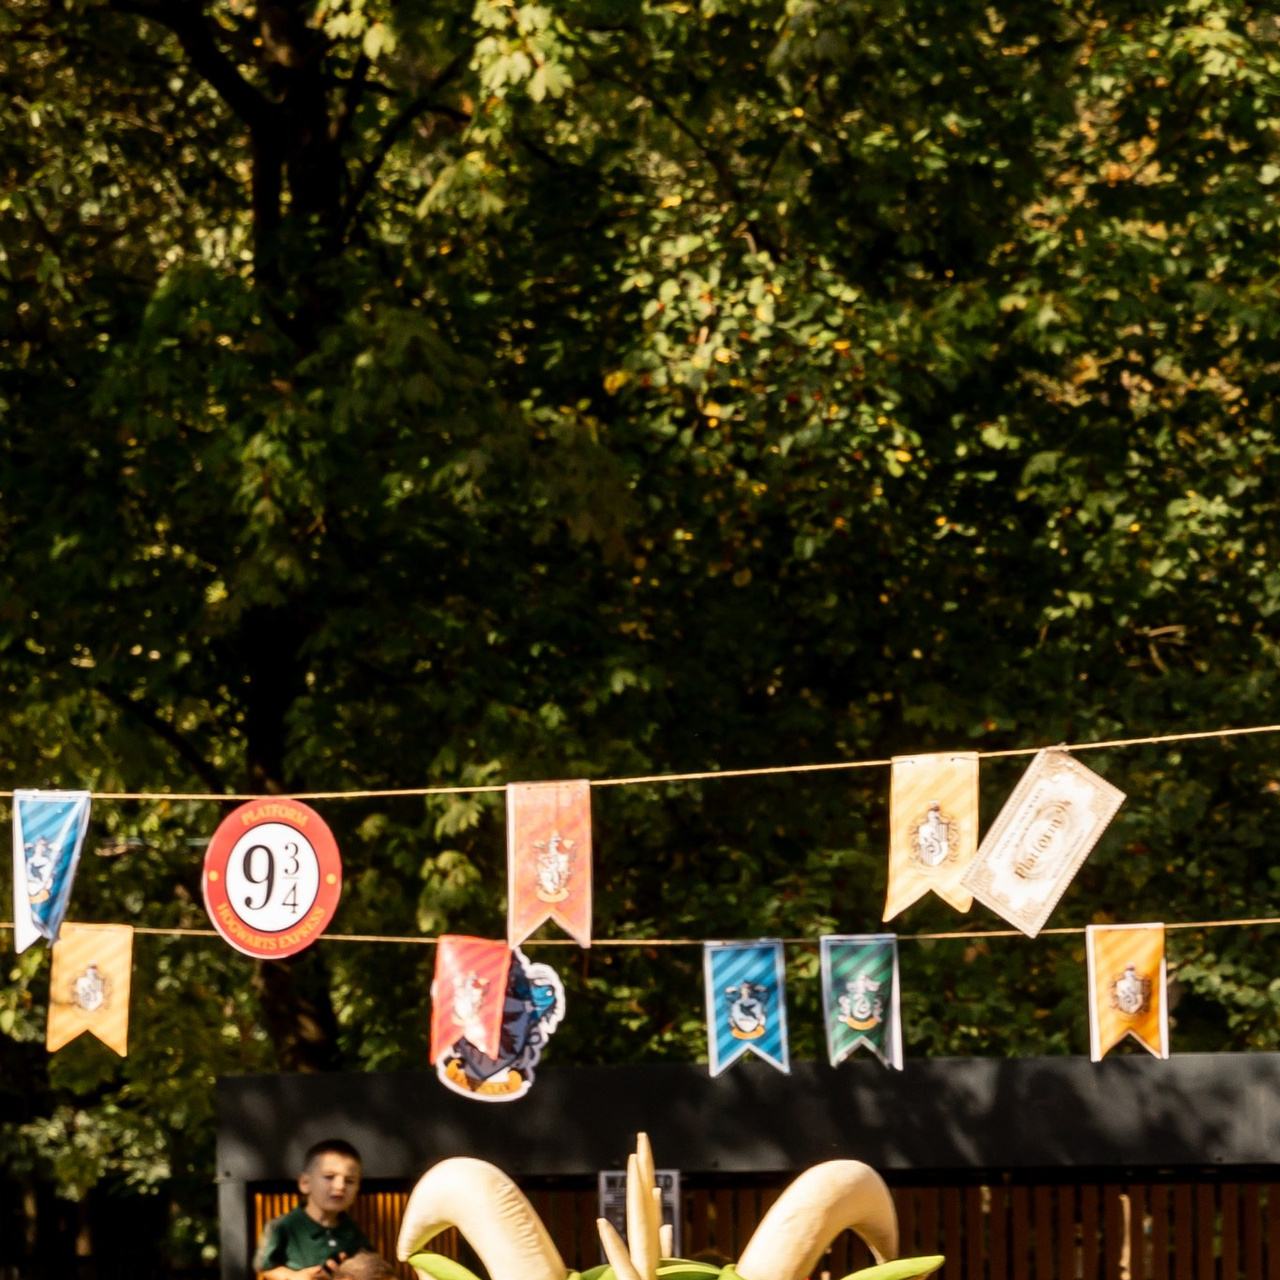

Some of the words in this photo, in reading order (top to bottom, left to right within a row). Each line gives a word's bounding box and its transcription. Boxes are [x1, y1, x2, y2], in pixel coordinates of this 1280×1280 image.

[241, 803, 309, 827] PLATFORM
[217, 902, 278, 950] HOGWARTS
[278, 905, 326, 949] EXPRESS
